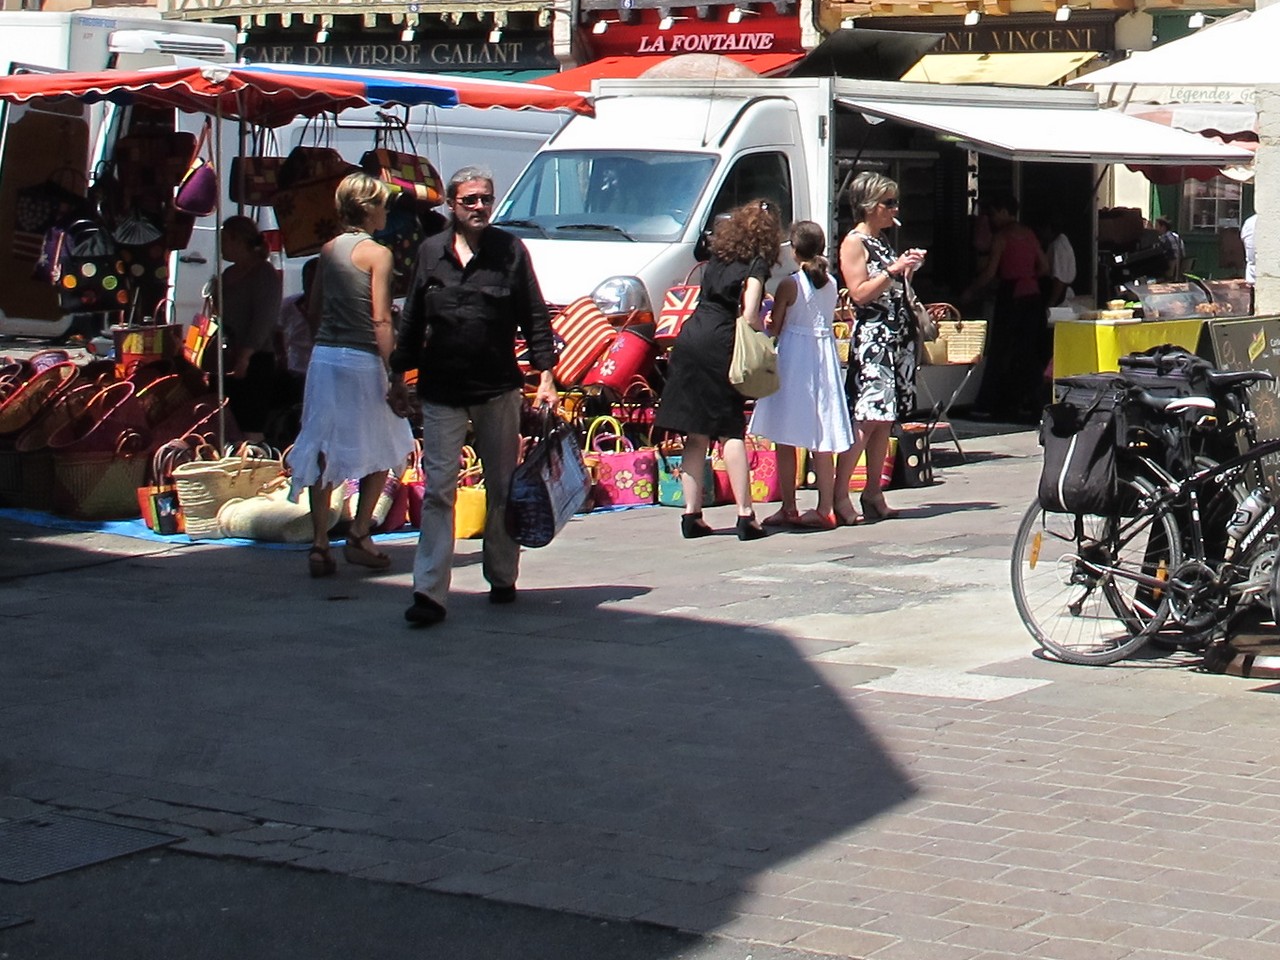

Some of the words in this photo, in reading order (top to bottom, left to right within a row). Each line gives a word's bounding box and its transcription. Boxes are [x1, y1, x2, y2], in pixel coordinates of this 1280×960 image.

[638, 36, 666, 52] LA
[670, 33, 775, 51] FONTAINE
[934, 31, 978, 51] INT
[993, 28, 1097, 50] VINCENT
[304, 45, 333, 66] DU
[344, 44, 420, 65] VERRE
[431, 42, 523, 64] GALANT
[1169, 86, 1231, 103] Légendes
